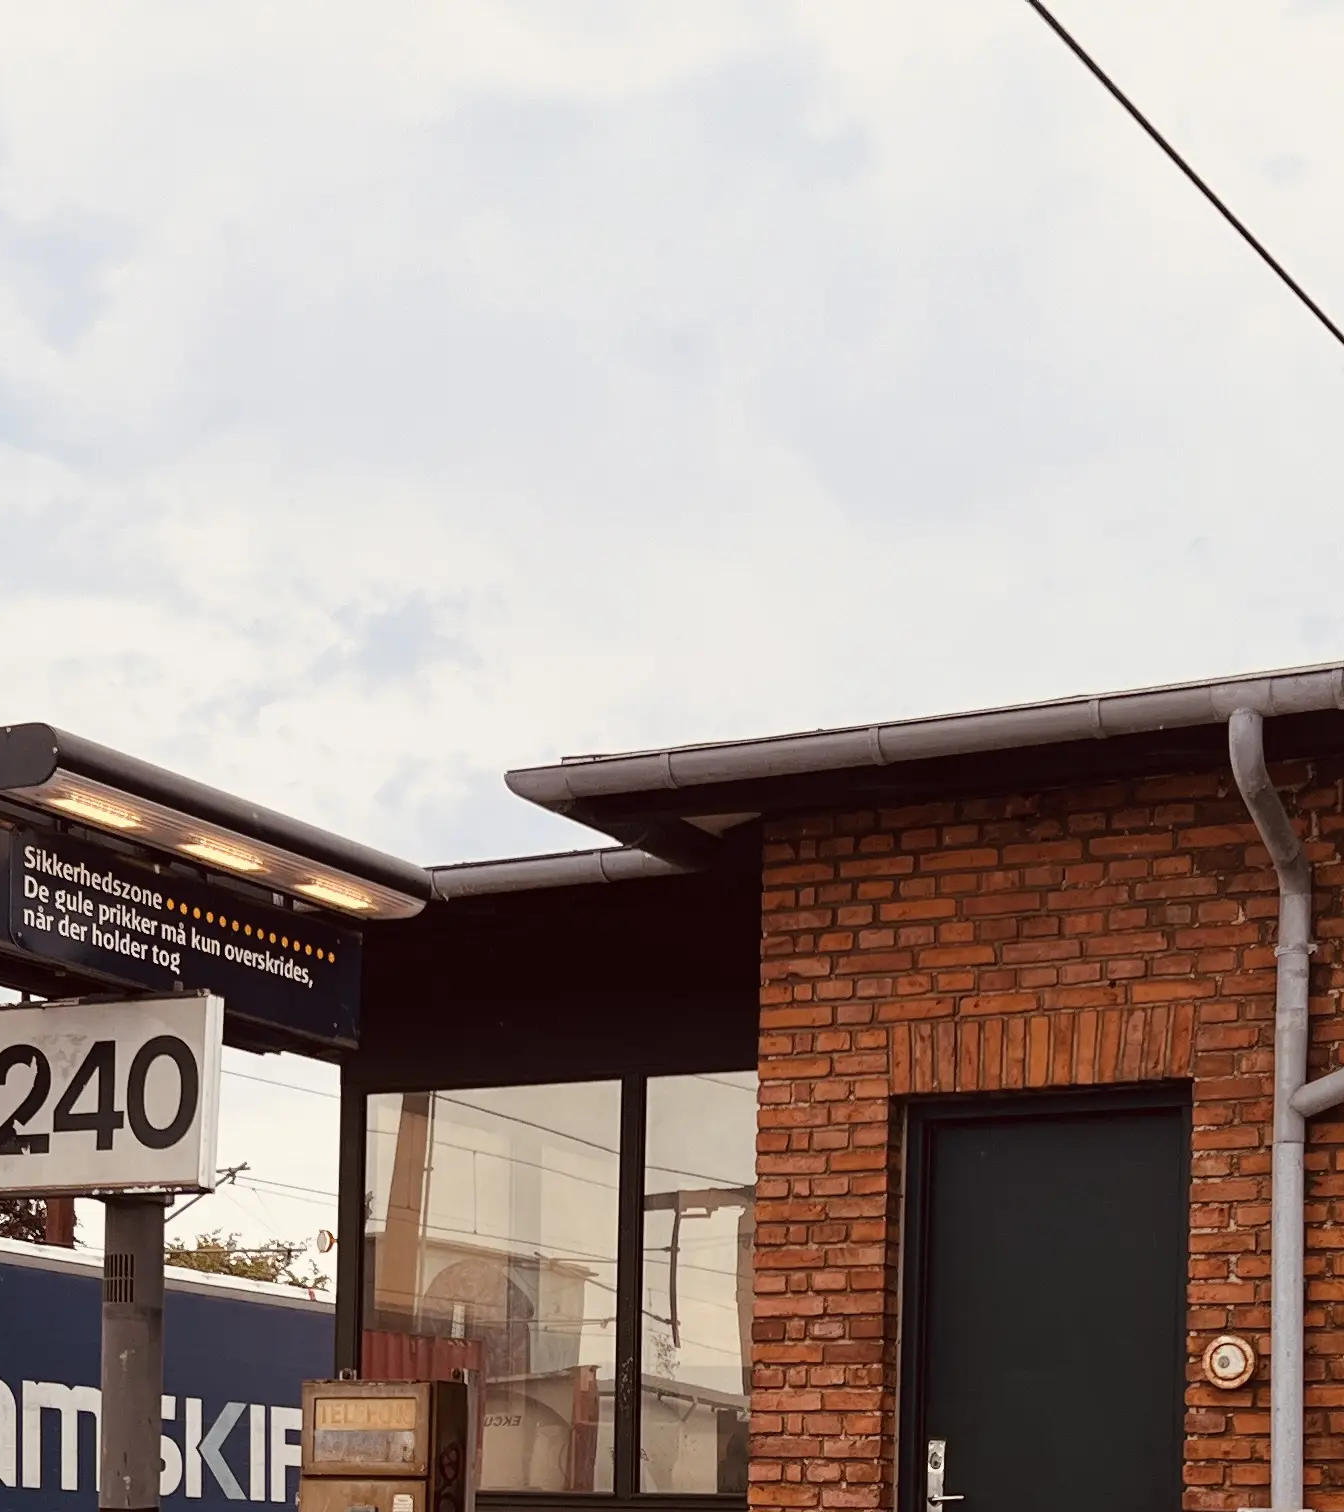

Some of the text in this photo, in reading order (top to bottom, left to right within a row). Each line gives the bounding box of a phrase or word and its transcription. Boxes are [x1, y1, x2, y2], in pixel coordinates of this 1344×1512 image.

[24, 845, 163, 910] Sikkerhedszone
[23, 905, 181, 975] når der holder tog
[24, 875, 313, 988] De gule prikker må kun overskrides,
